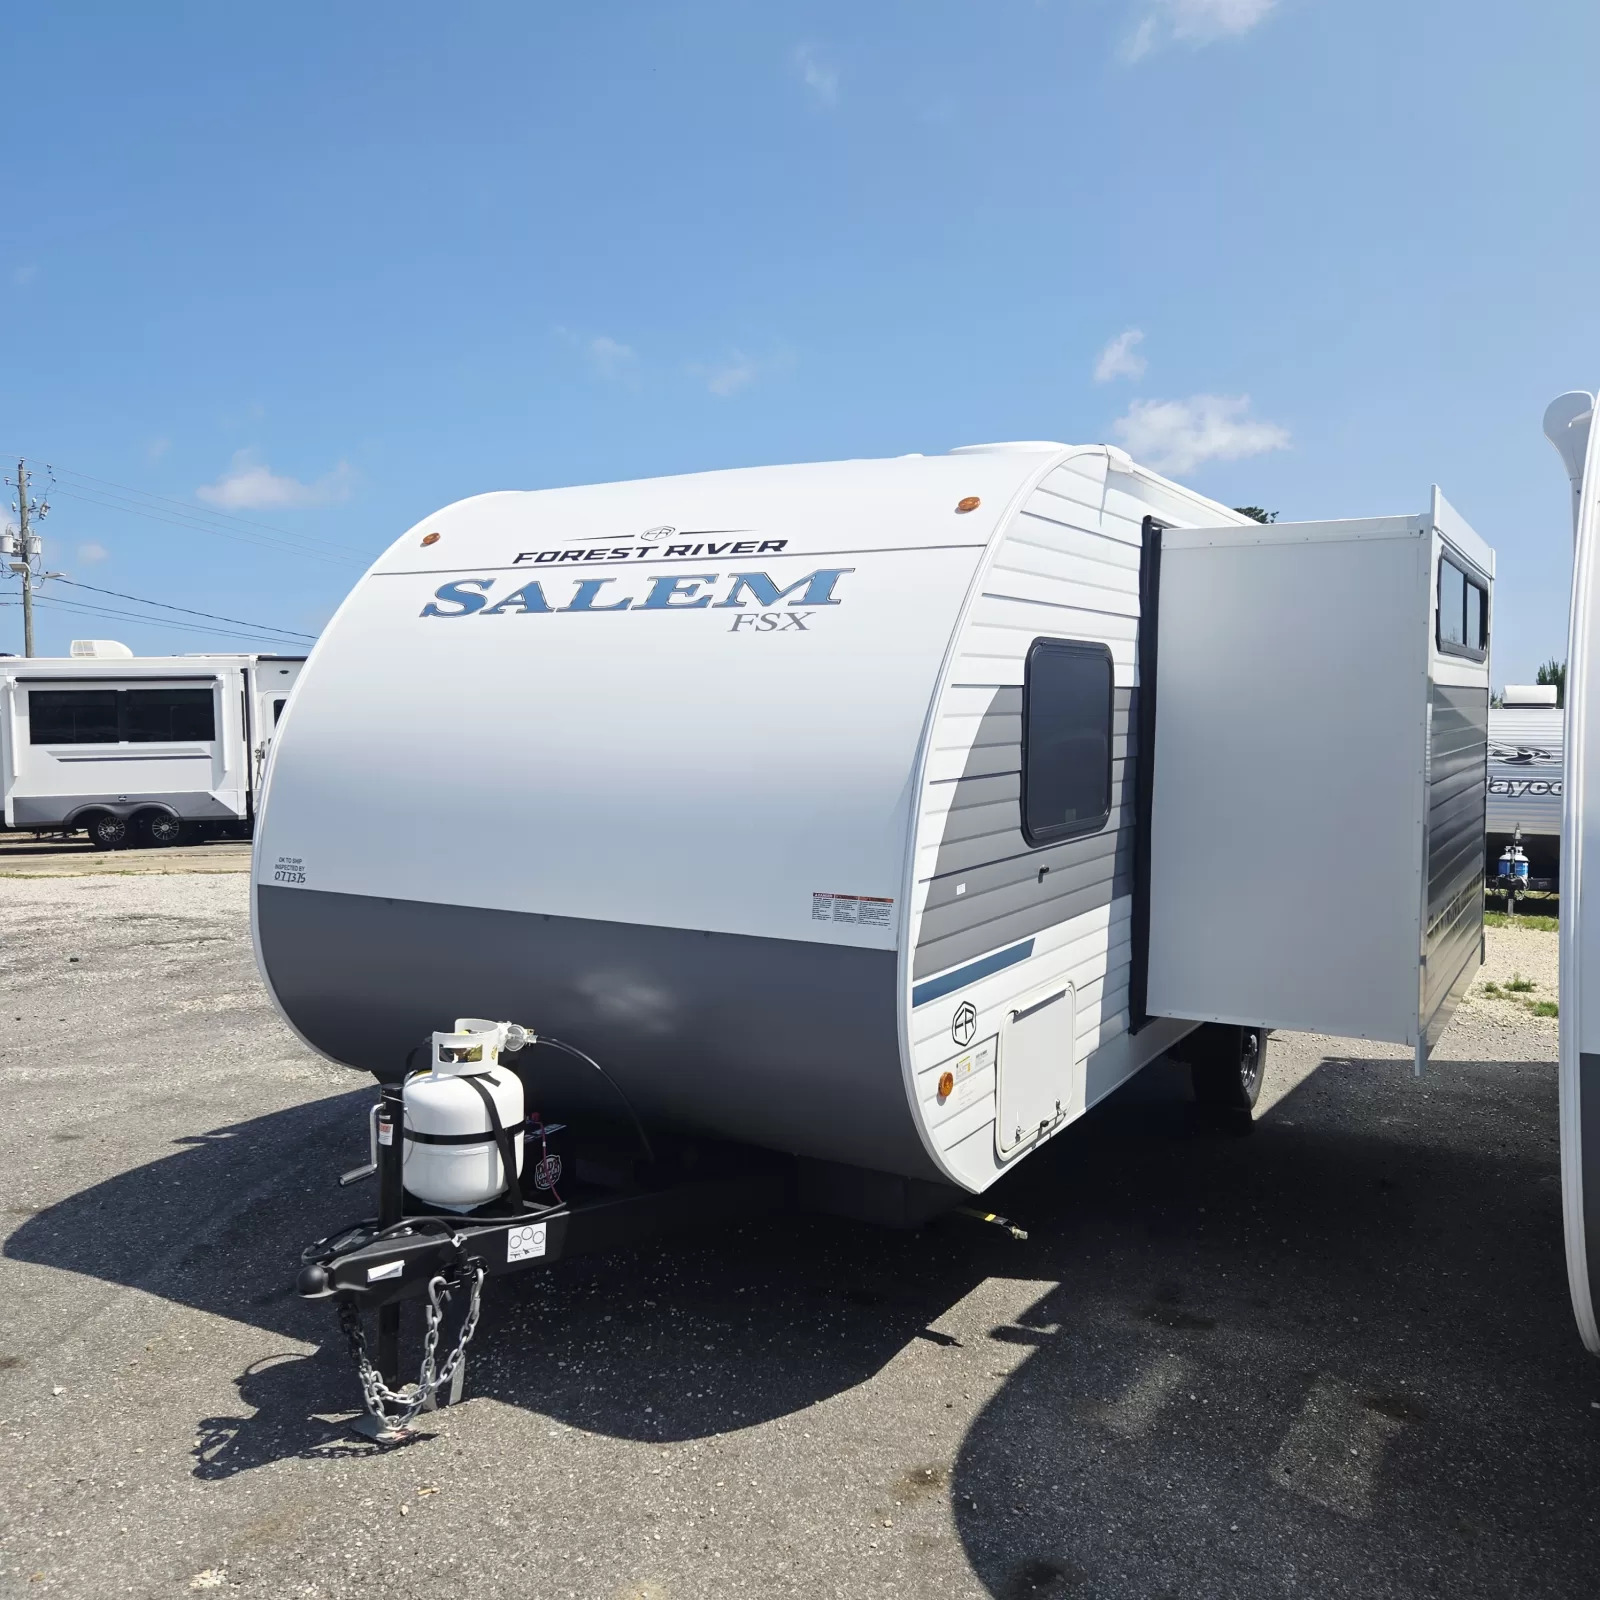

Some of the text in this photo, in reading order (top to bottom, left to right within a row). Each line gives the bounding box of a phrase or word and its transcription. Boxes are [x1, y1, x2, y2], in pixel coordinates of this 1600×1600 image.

[512, 539, 788, 564] FOREST RIVER
[419, 568, 856, 619] SALEM
[727, 612, 816, 632] FSX
